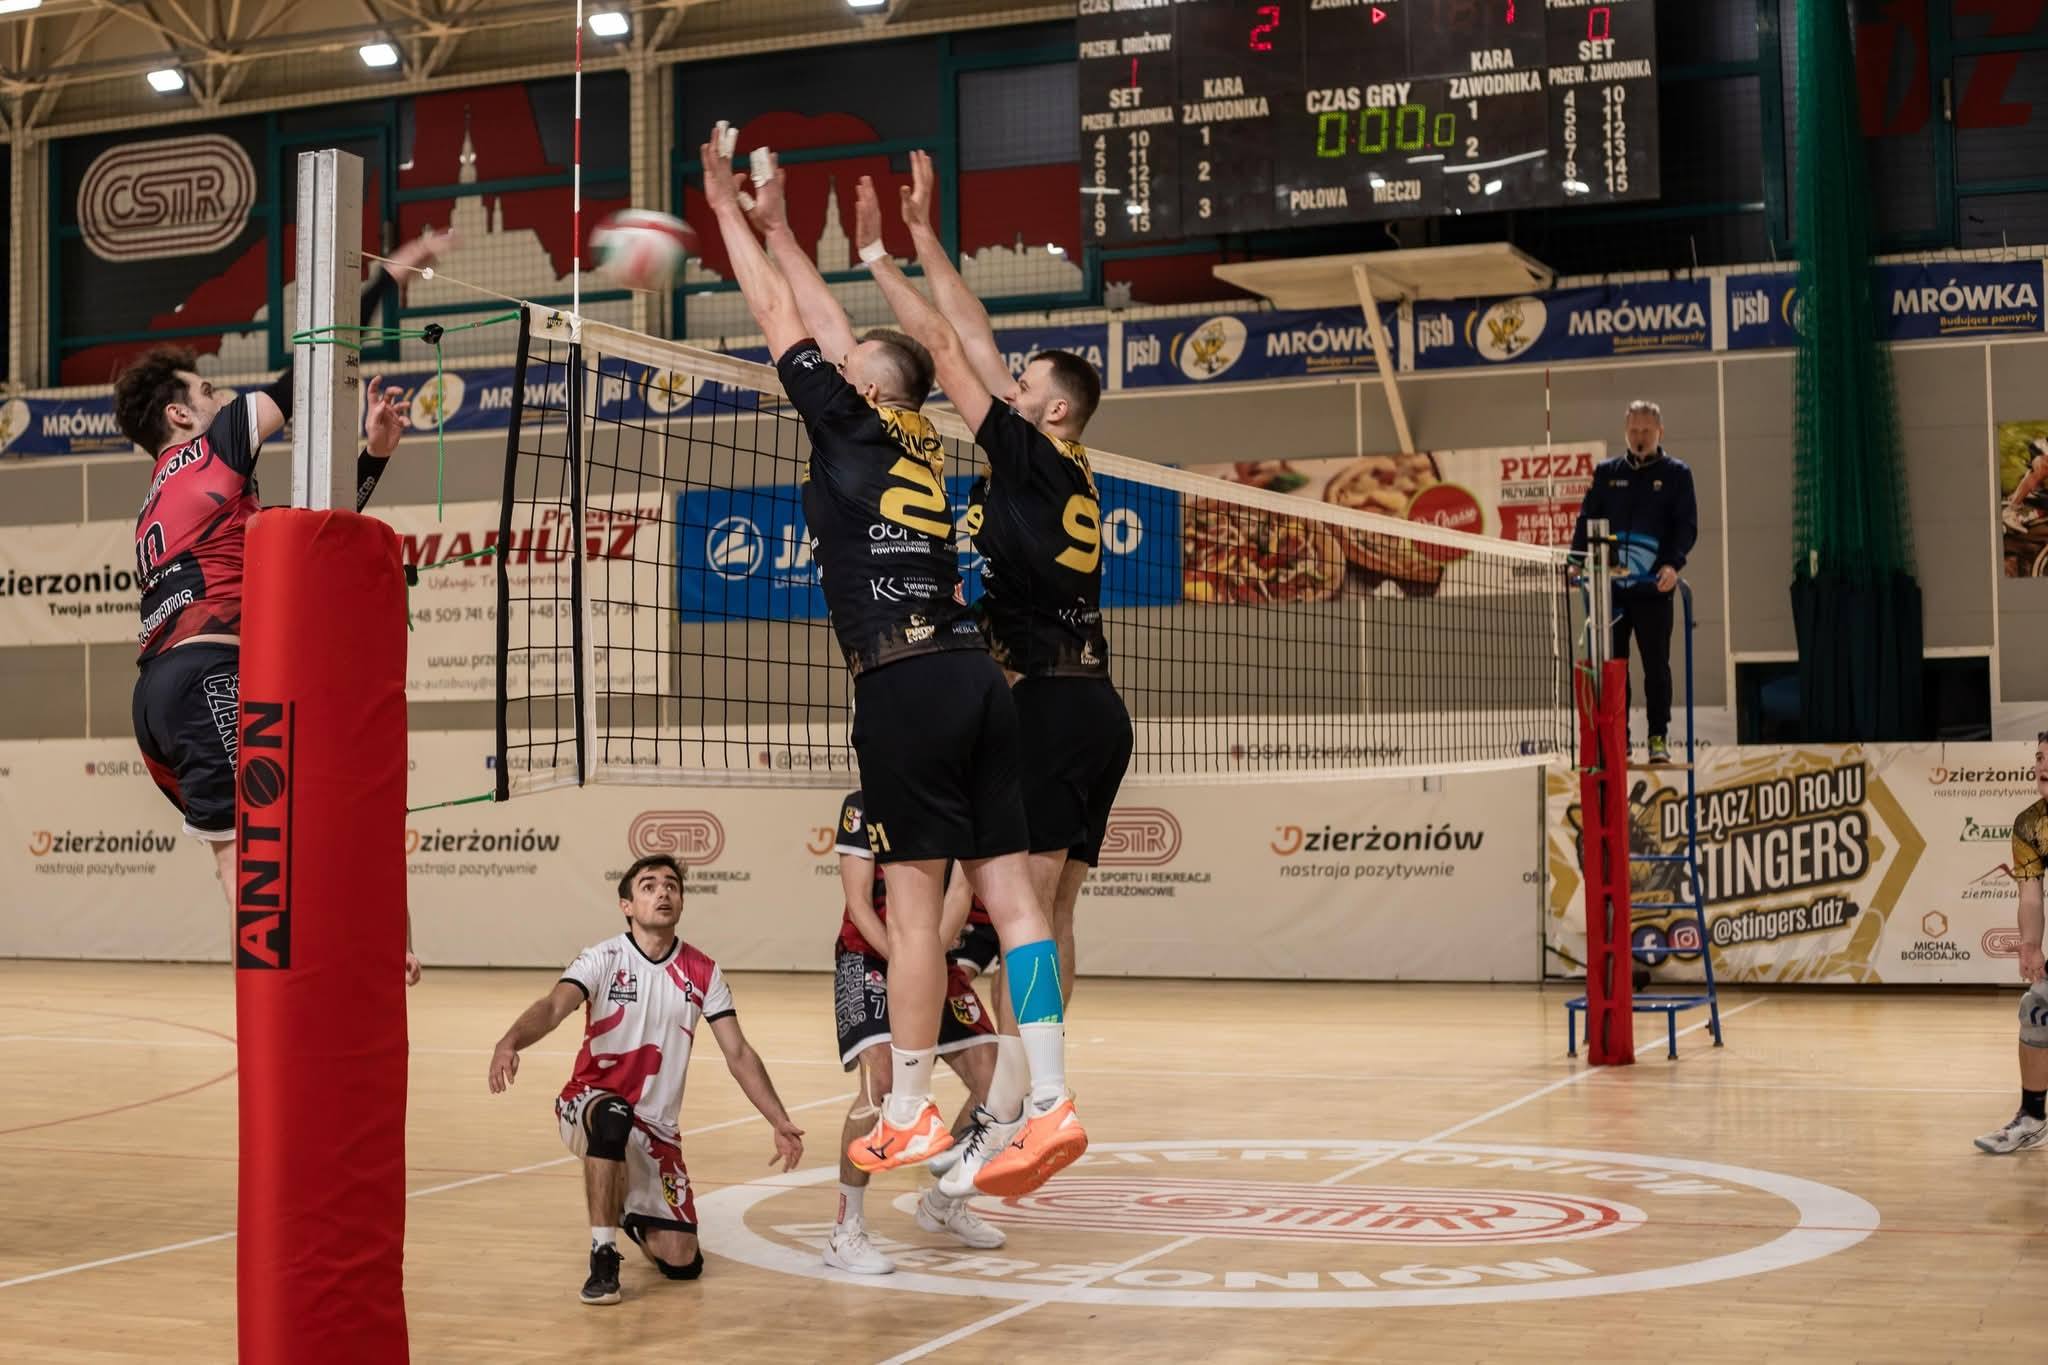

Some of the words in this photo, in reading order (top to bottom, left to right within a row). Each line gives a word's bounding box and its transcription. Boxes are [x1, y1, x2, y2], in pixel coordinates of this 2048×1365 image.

[1250, 6, 1279, 50] 2
[1122, 31, 1172, 55] DRUŻYNY
[1578, 39, 1615, 61] SET
[1471, 48, 1514, 72] KARA
[1549, 66, 1588, 85] PRZEW.
[1590, 59, 1651, 81] ZAWODNIKA
[1203, 76, 1244, 98] KARA
[1449, 70, 1542, 99] ZAWODNIKA
[1109, 88, 1142, 108] SET
[1306, 87, 1360, 114] CZAS
[1366, 82, 1411, 107] GRY
[1563, 89, 1575, 106] 4
[1602, 86, 1625, 104] 10
[1182, 97, 1269, 124] ZAWODNIKA
[1468, 100, 1478, 120] 1
[1564, 108, 1576, 124] 5
[1602, 104, 1623, 121] 11
[1094, 135, 1106, 149] 4
[1129, 131, 1149, 147] 10
[1200, 126, 1210, 145] 1
[1564, 125, 1576, 142] 6
[1603, 122, 1626, 139] 12
[1465, 136, 1479, 158] 2
[1565, 143, 1577, 160] 7
[1603, 139, 1626, 157] 13
[1094, 152, 1106, 168] 5
[1129, 149, 1147, 165] 11
[1565, 161, 1577, 179] 8
[1604, 159, 1628, 176] 14
[1094, 169, 1106, 185] 6
[1129, 166, 1149, 181] 12
[1198, 161, 1211, 181] 2
[1129, 183, 1149, 198] 13
[1467, 173, 1480, 194] 3
[1606, 175, 1629, 193] 15
[1290, 187, 1347, 210] POŁOWA
[1374, 180, 1421, 203] MECZU
[1095, 202, 1106, 218] 8
[1199, 198, 1211, 218] 3
[1095, 219, 1106, 236] 9
[1129, 217, 1150, 232] 15
[1892, 278, 2038, 316] MRÓWKA
[1568, 299, 1706, 336] MRÓWKA
[1732, 290, 1770, 332] psb
[1418, 313, 1454, 353] psb
[1127, 335, 1161, 373] psb
[43, 408, 122, 437] MRÓWK
[1501, 454, 1594, 481] PIZZA
[880, 456, 951, 539] 2
[541, 507, 662, 528] Prewozy
[1055, 493, 1101, 574] 9
[49, 603, 91, 617] Twoja
[435, 608, 461, 621] 509
[1928, 766, 2037, 785] Dzierżonió
[1664, 789, 1750, 840] DOŁĄCZ
[1759, 781, 1791, 820] DO
[1799, 767, 1862, 813] ROJU
[1933, 788, 1977, 799] nastraja
[30, 829, 176, 857] Dzierżoniów
[1270, 824, 1484, 857] Dzierżoniów
[35, 861, 84, 876] nastraja
[86, 861, 157, 876] pozytywnie
[408, 862, 456, 876] astraja
[458, 862, 538, 876] pozytywnie
[1680, 815, 1863, 904] STINGERS
[696, 872, 750, 882] REKREACJI
[1100, 872, 1143, 882] SPORTU
[1151, 872, 1211, 883] REKREACJI
[1280, 862, 1350, 880] nastraja
[1354, 862, 1455, 880] pozytywnie
[1081, 887, 1090, 896] W
[1093, 885, 1176, 897] DZIERŻONIOWIE
[1713, 899, 1845, 946] @stingers.ddz
[1901, 950, 1971, 961] BORODAJKO
[1914, 940, 1957, 951] MICHAŁ
[685, 981, 694, 1002] 2
[871, 995, 886, 1020] 7
